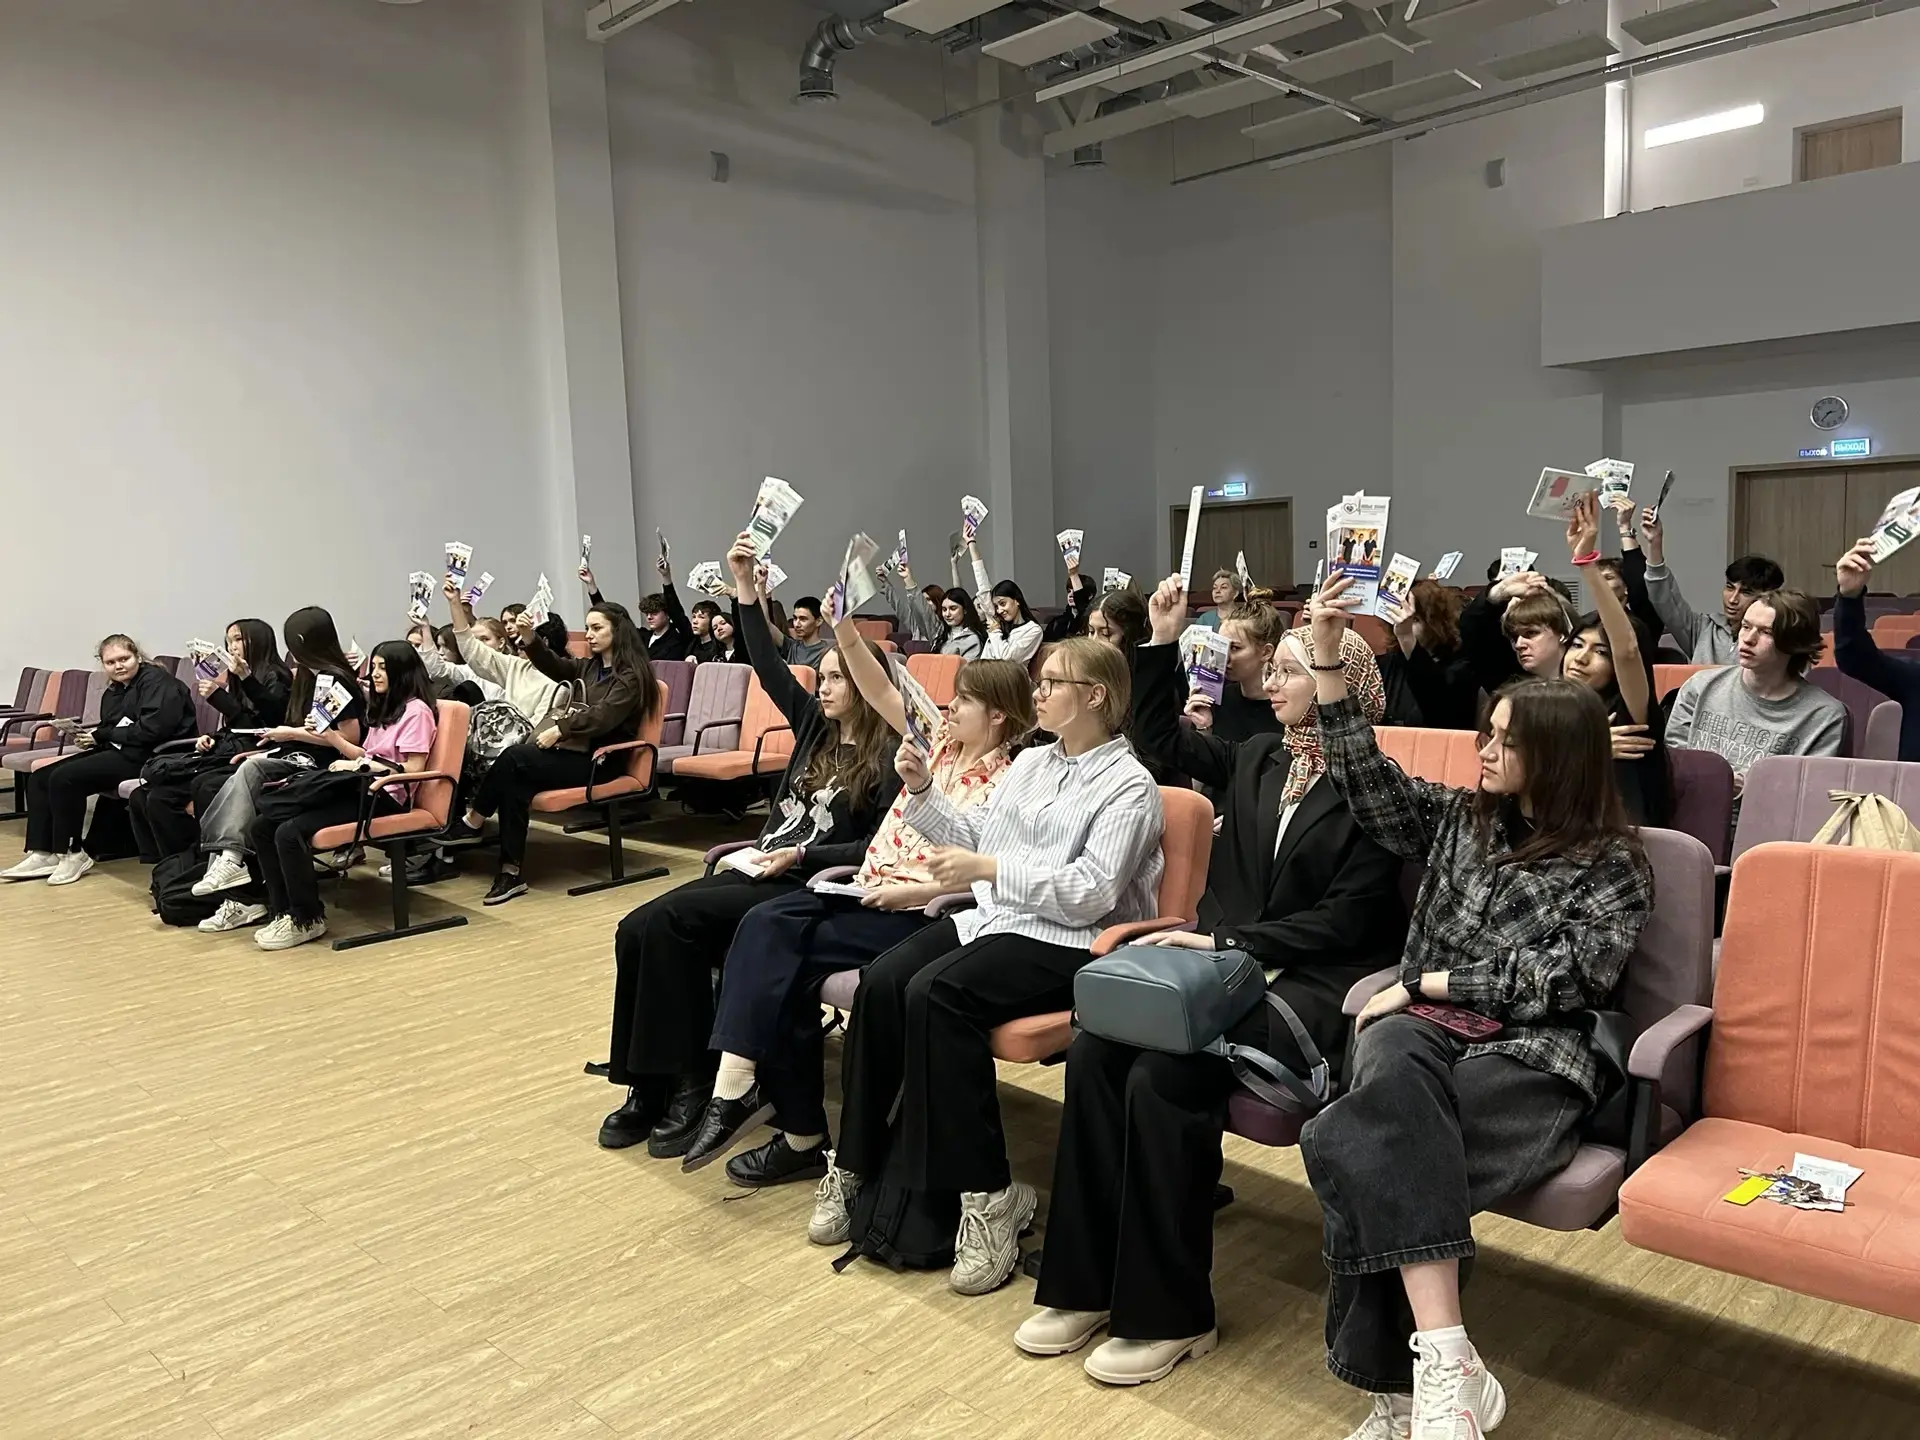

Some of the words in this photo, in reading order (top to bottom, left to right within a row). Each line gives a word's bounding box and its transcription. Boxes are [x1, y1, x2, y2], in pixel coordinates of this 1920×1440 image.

[1835, 441, 1866, 452] ВЫХОД
[1692, 729, 1736, 760] NEW
[1698, 710, 1800, 755] HILFIGER
